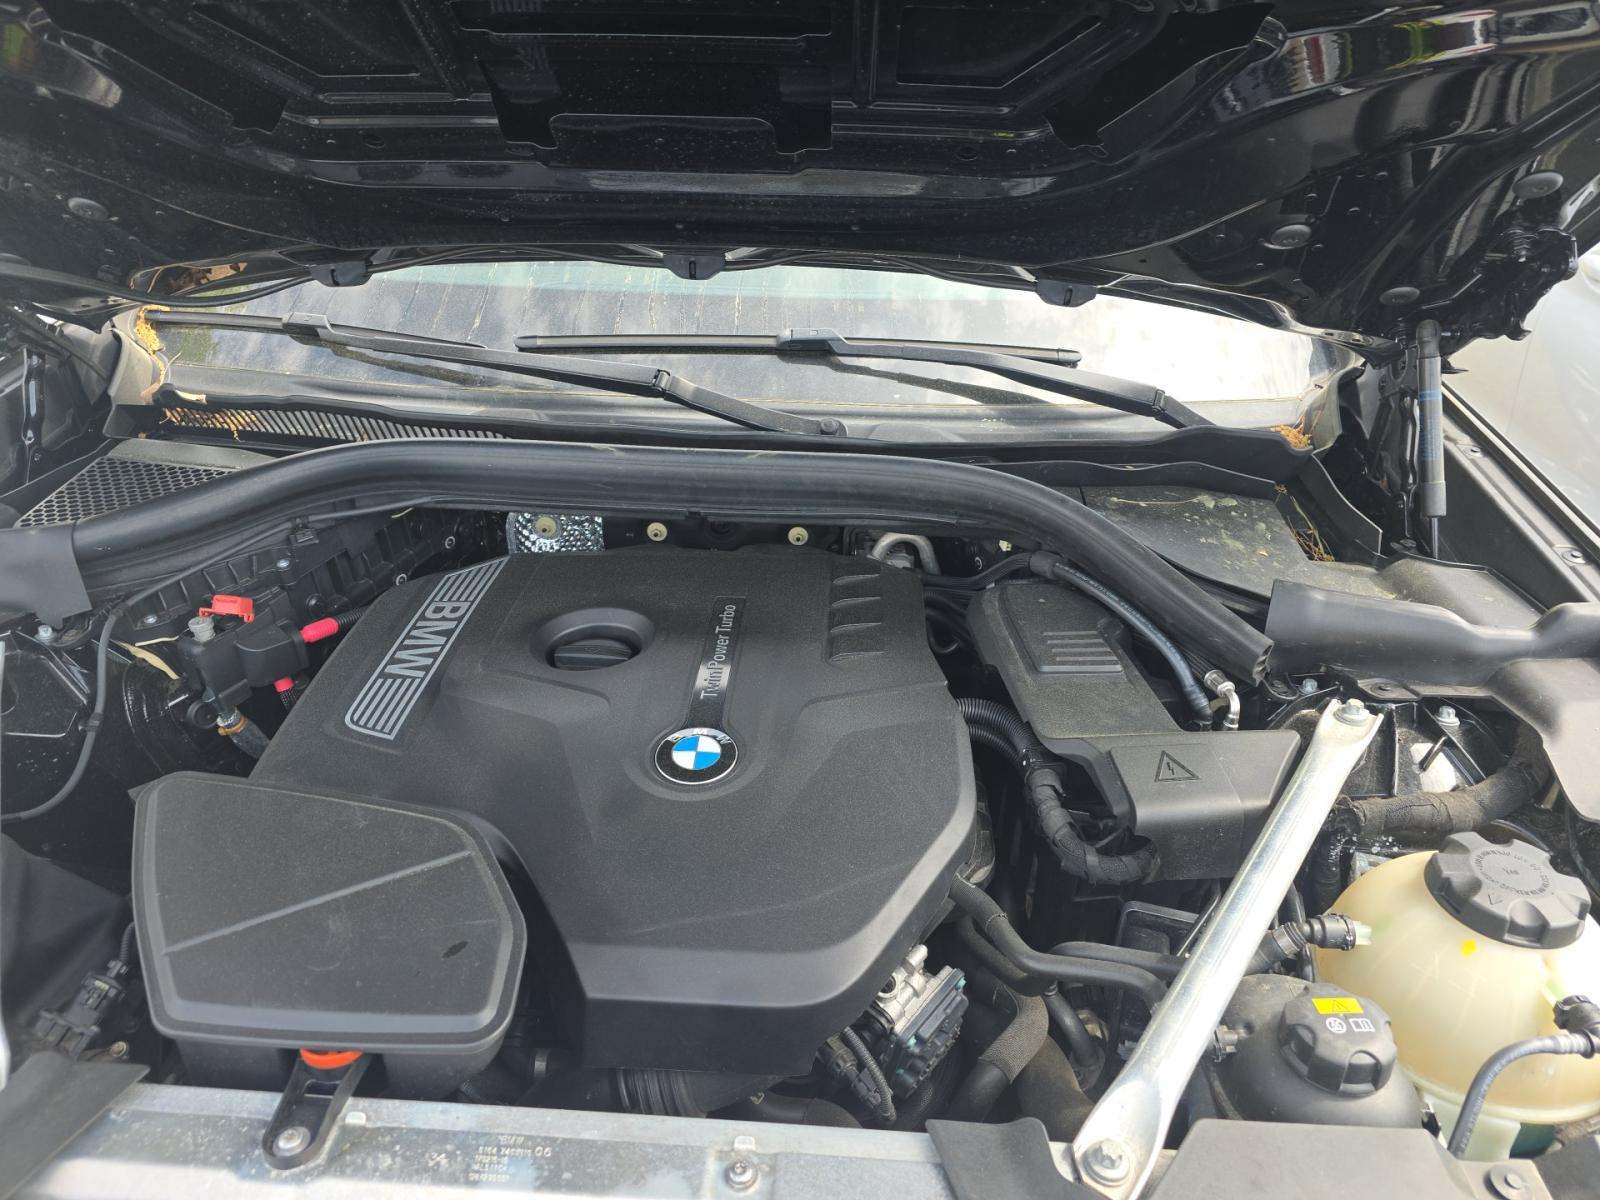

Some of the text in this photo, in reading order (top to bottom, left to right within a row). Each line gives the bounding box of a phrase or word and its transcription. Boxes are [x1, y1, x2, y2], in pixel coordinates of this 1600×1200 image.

[385, 601, 471, 678] BMW
[699, 603, 737, 700] TwinPower Turbo
